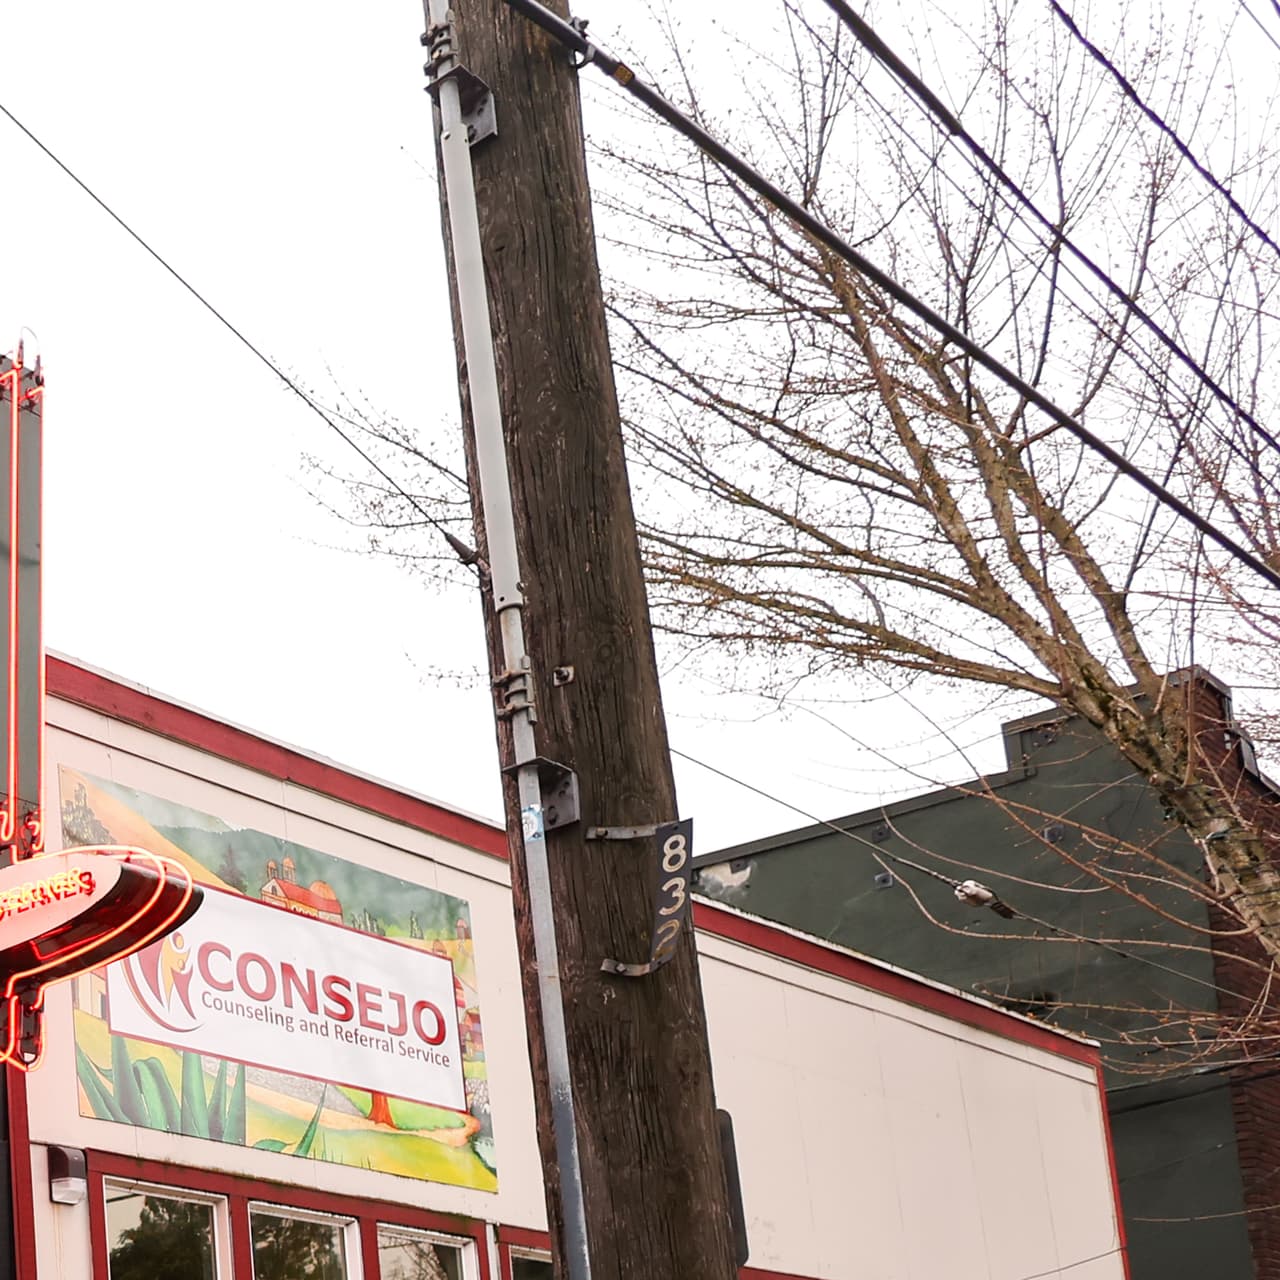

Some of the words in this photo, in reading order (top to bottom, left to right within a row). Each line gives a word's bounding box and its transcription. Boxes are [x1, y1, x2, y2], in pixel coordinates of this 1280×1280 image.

[653, 834, 687, 961] 832
[197, 940, 447, 1046] CONSEJO
[202, 990, 295, 1032] Counseling
[299, 1016, 329, 1037] and
[335, 1023, 394, 1054] Referral
[398, 1040, 450, 1067] Service
